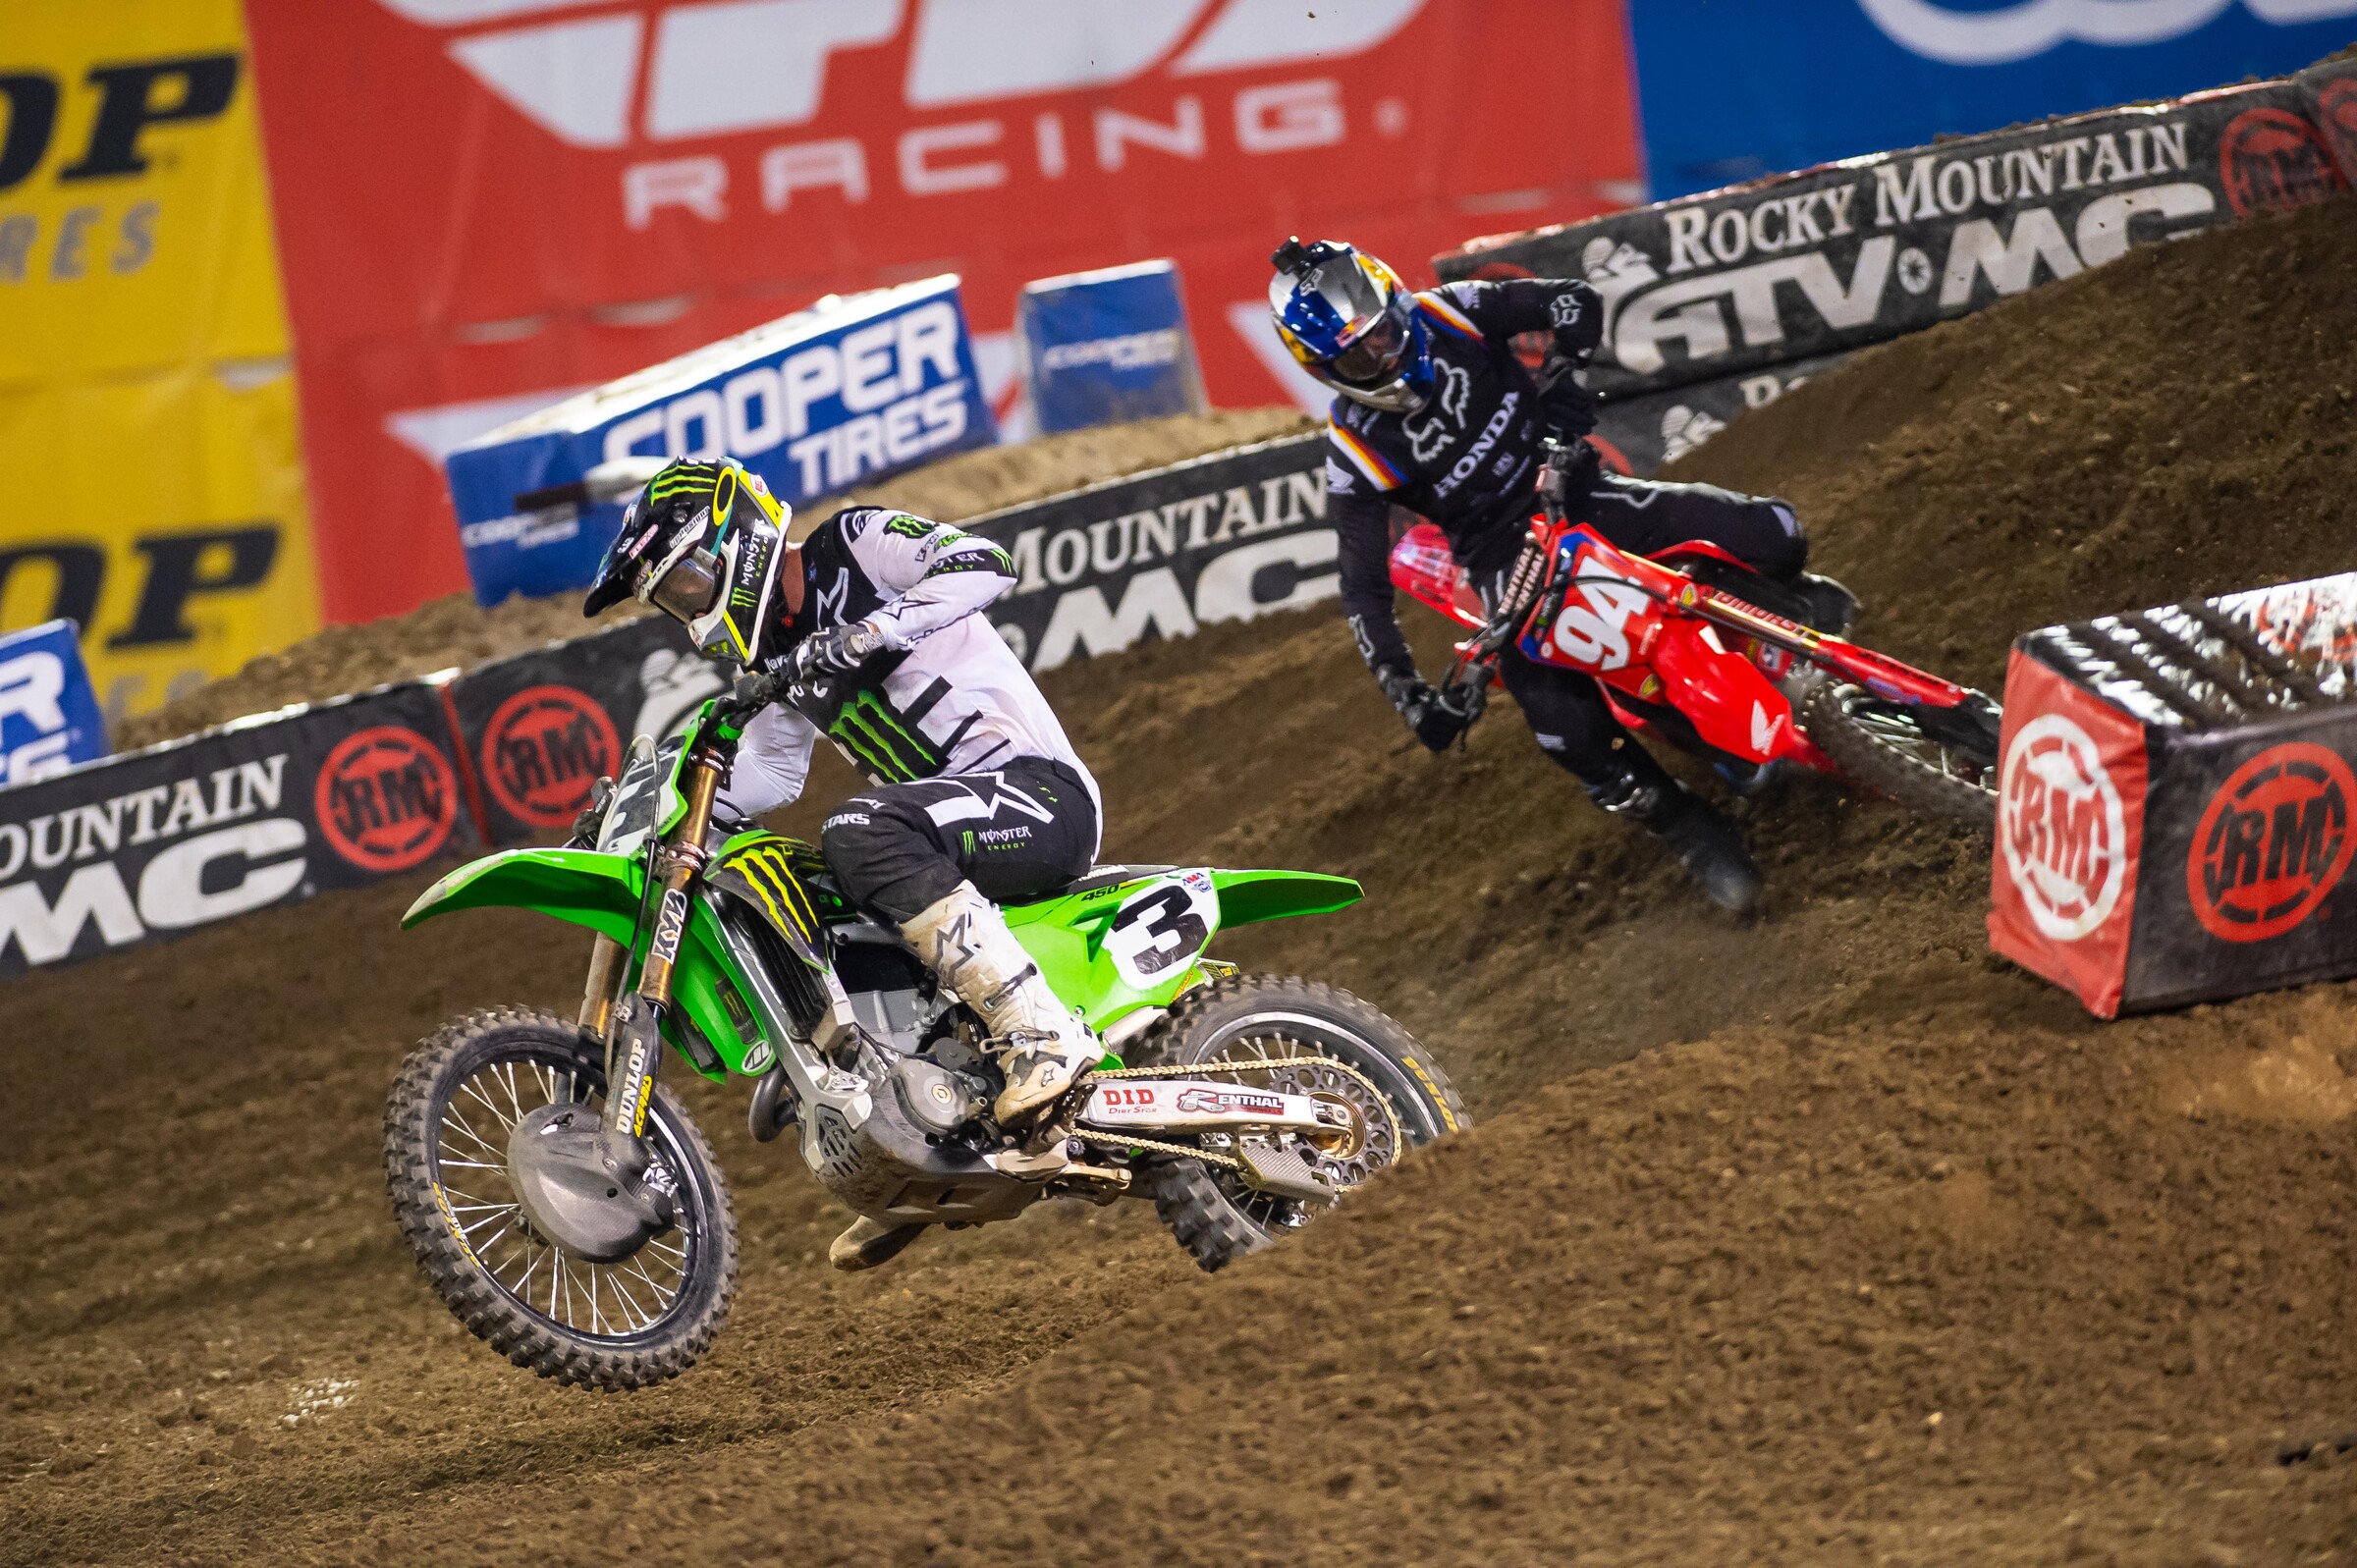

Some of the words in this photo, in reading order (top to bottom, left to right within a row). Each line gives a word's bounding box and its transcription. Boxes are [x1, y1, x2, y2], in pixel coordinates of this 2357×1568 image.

[623, 79, 1345, 230] RACING
[1667, 184, 1857, 273] ROCKY
[1874, 123, 2189, 226] MOUNTAIN
[604, 300, 959, 460] COOPER
[789, 383, 967, 496] TIRES
[1434, 392, 1520, 500] HONDA
[1031, 528, 1343, 674] MC
[1555, 555, 1652, 672] 94
[978, 825, 1032, 844] MONSTER
[651, 888, 687, 966] KYB
[1081, 884, 1120, 901] 450
[1110, 886, 1209, 975] 3
[615, 1038, 647, 1134] DUNLOP
[633, 1075, 653, 1138] ACERBIS
[1180, 1090, 1283, 1113] RENTHAL
